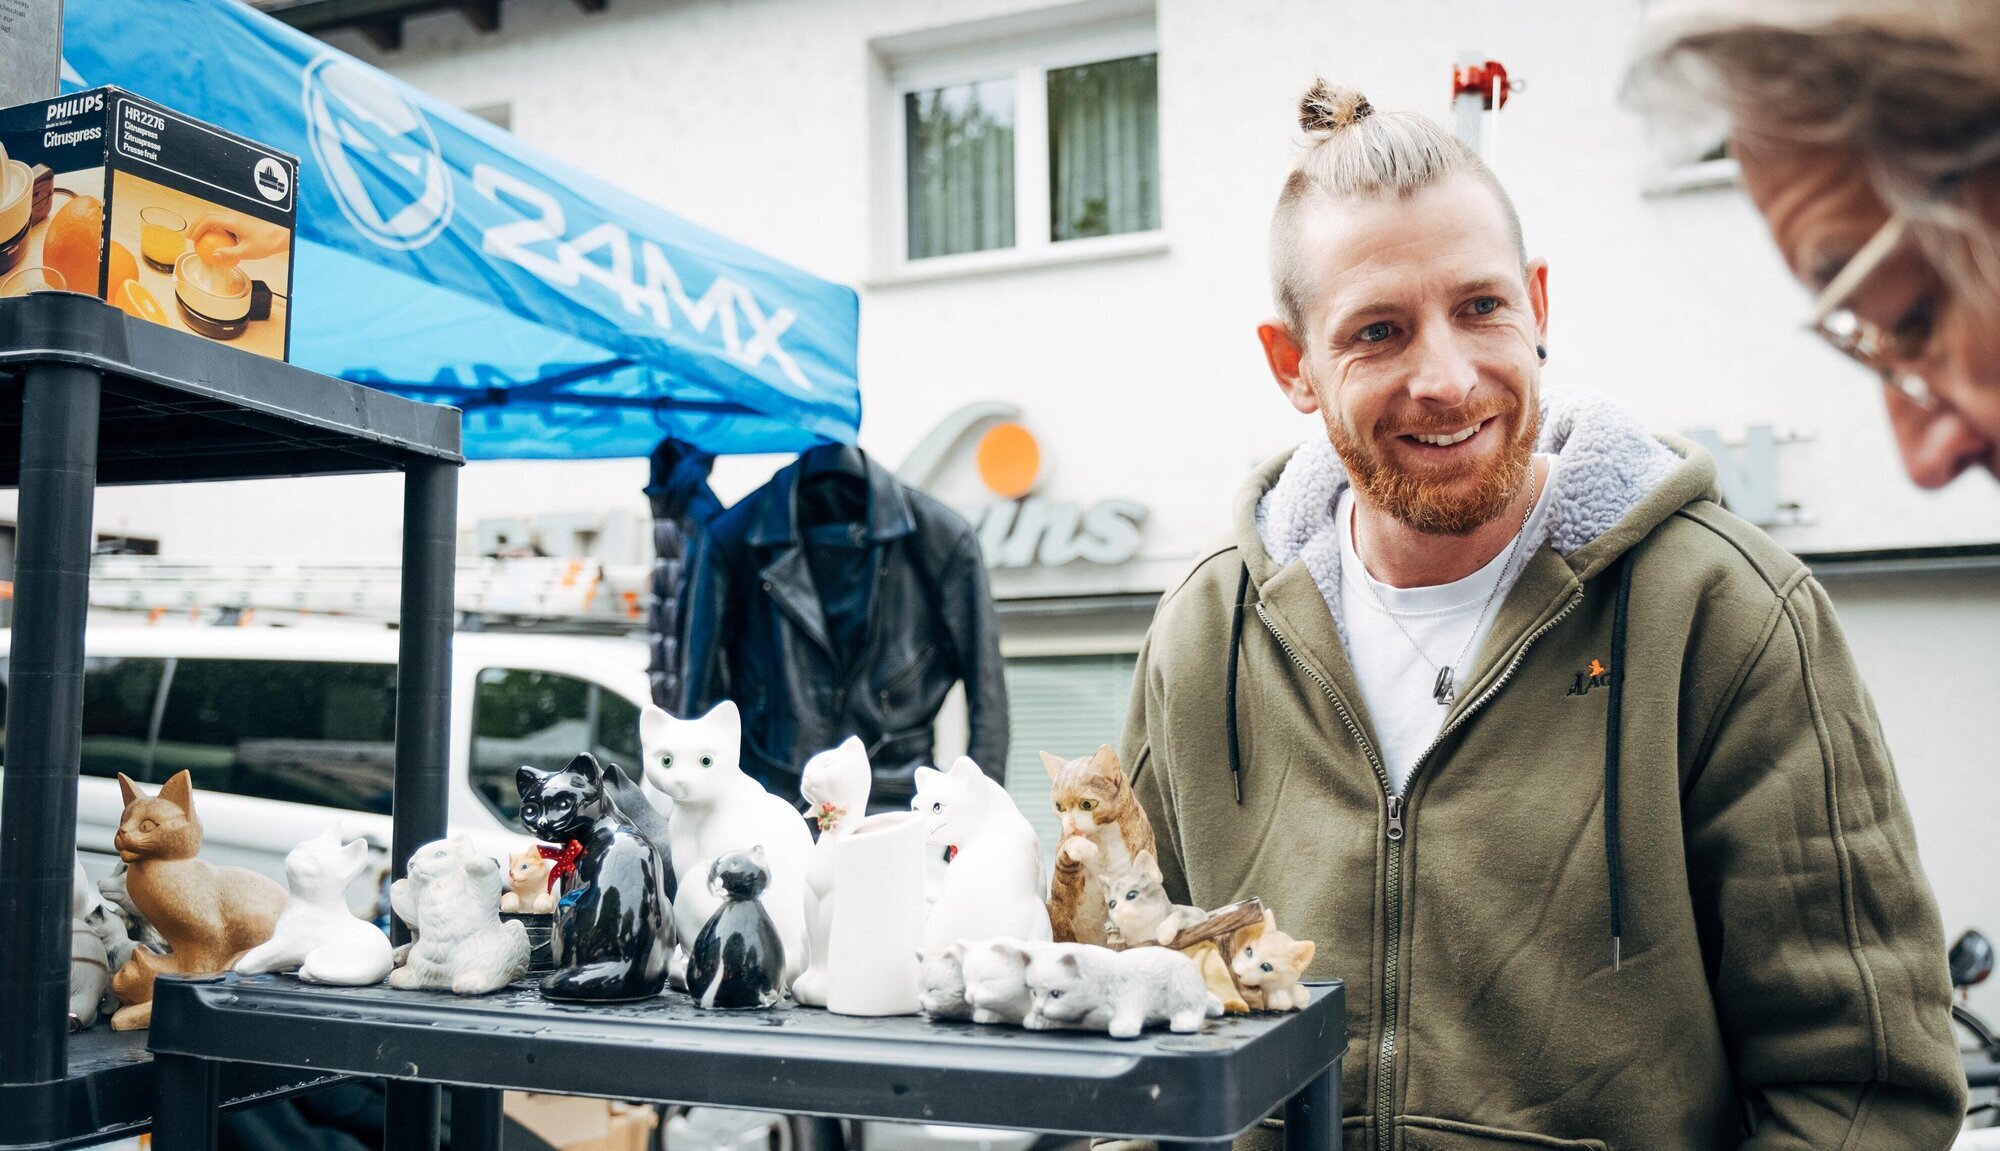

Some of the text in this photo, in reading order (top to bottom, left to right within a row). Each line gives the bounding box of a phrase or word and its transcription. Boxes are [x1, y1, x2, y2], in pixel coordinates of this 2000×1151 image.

[46, 94, 104, 121] PHILIPS
[125, 105, 165, 131] HR2276
[44, 127, 102, 148] Citruspress
[124, 120, 158, 139] Citruspress
[123, 131, 161, 151] Zitruspresse
[123, 141, 158, 161] Presse fruit
[472, 162, 814, 391] 24MX
